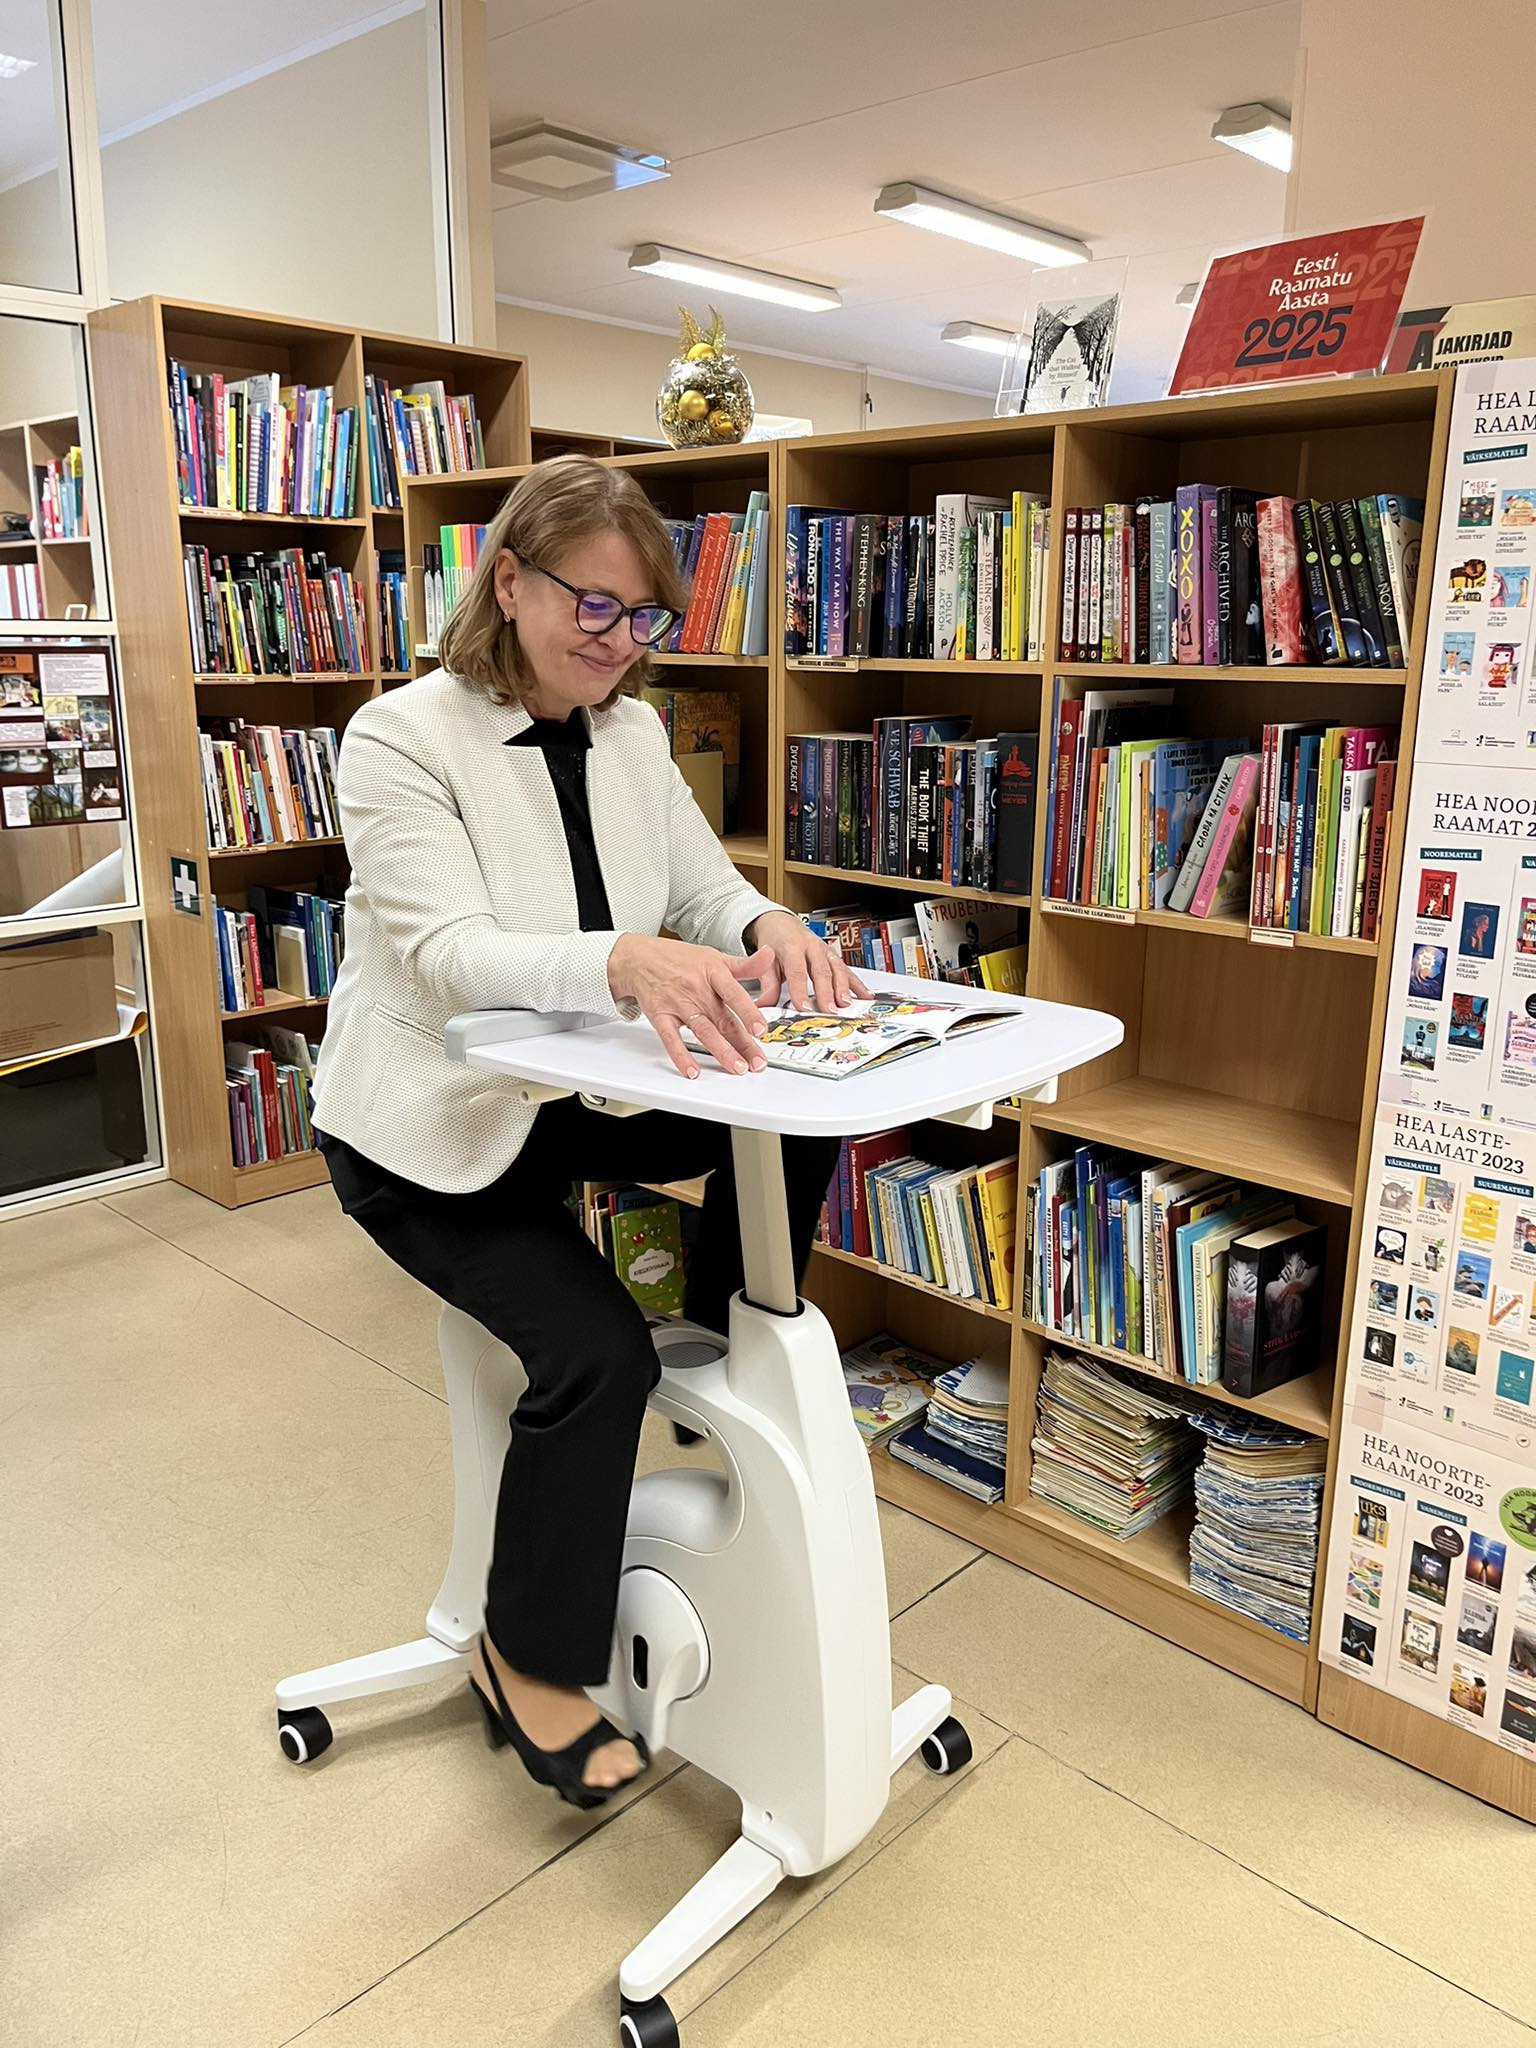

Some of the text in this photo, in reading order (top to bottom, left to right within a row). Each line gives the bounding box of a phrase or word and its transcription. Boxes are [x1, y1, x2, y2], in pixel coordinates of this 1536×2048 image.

[1293, 252, 1339, 276] Eesti
[1269, 271, 1352, 297] Raamatu
[1278, 292, 1329, 312] Aasta
[1235, 305, 1353, 367] 2025
[1477, 392, 1522, 410] HEA
[1465, 447, 1526, 462] VÄIKSEMATELE
[834, 521, 842, 543] THE
[938, 513, 948, 576] RACHEL PRICE
[946, 517, 957, 572] REAPPEARANCE
[1153, 513, 1166, 583] LET IT SNOW
[807, 526, 816, 584] RONALDO
[834, 546, 842, 569] WAY
[857, 524, 870, 608] STEPHEN KING
[1179, 505, 1195, 600] XOXO
[785, 532, 799, 632] Up In Flames
[833, 580, 841, 598] AM
[984, 551, 993, 602] STEALING
[1217, 541, 1230, 622] ARCHIVED
[1336, 569, 1350, 612] RISING STORM
[832, 601, 841, 629] NOW
[938, 587, 946, 631] JACKSON
[945, 593, 953, 625] HOLLY
[1377, 582, 1395, 617] NOW
[789, 744, 799, 793] DIVERGENT
[823, 748, 833, 796] INSURGENT
[1345, 736, 1355, 770] ТАКСА
[888, 750, 901, 808] SCHWAB
[1343, 785, 1352, 812] ДОГ
[909, 785, 918, 839] MARKUS ZUSAK
[917, 768, 930, 853] THE BOOK THIEF
[1197, 773, 1232, 849] СЛОВА НА СТІНАХ
[1435, 793, 1478, 810] HEA
[804, 822, 812, 851] ROTH
[1295, 819, 1303, 834] CAT
[1433, 813, 1523, 836] RAAMAT
[1367, 825, 1384, 916] Я БЫЛ ЗДЕСЬ
[1424, 851, 1478, 859] NOOREMATELE
[1396, 1113, 1511, 1149] HEA LASTE-
[1387, 1157, 1439, 1173] VÄIKSEMATELE
[1393, 1132, 1524, 1174] RAAMAT 2023
[1477, 1180, 1531, 1196] SUUREMATELE
[1152, 1201, 1165, 1281] MEIE AABITS
[1361, 1451, 1484, 1508] RAAMAT 2023
[1363, 1434, 1492, 1490] HEA NOORTE-
[1353, 1478, 1403, 1499] NOOREMATELE
[1420, 1504, 1464, 1524] VANEMATELE
